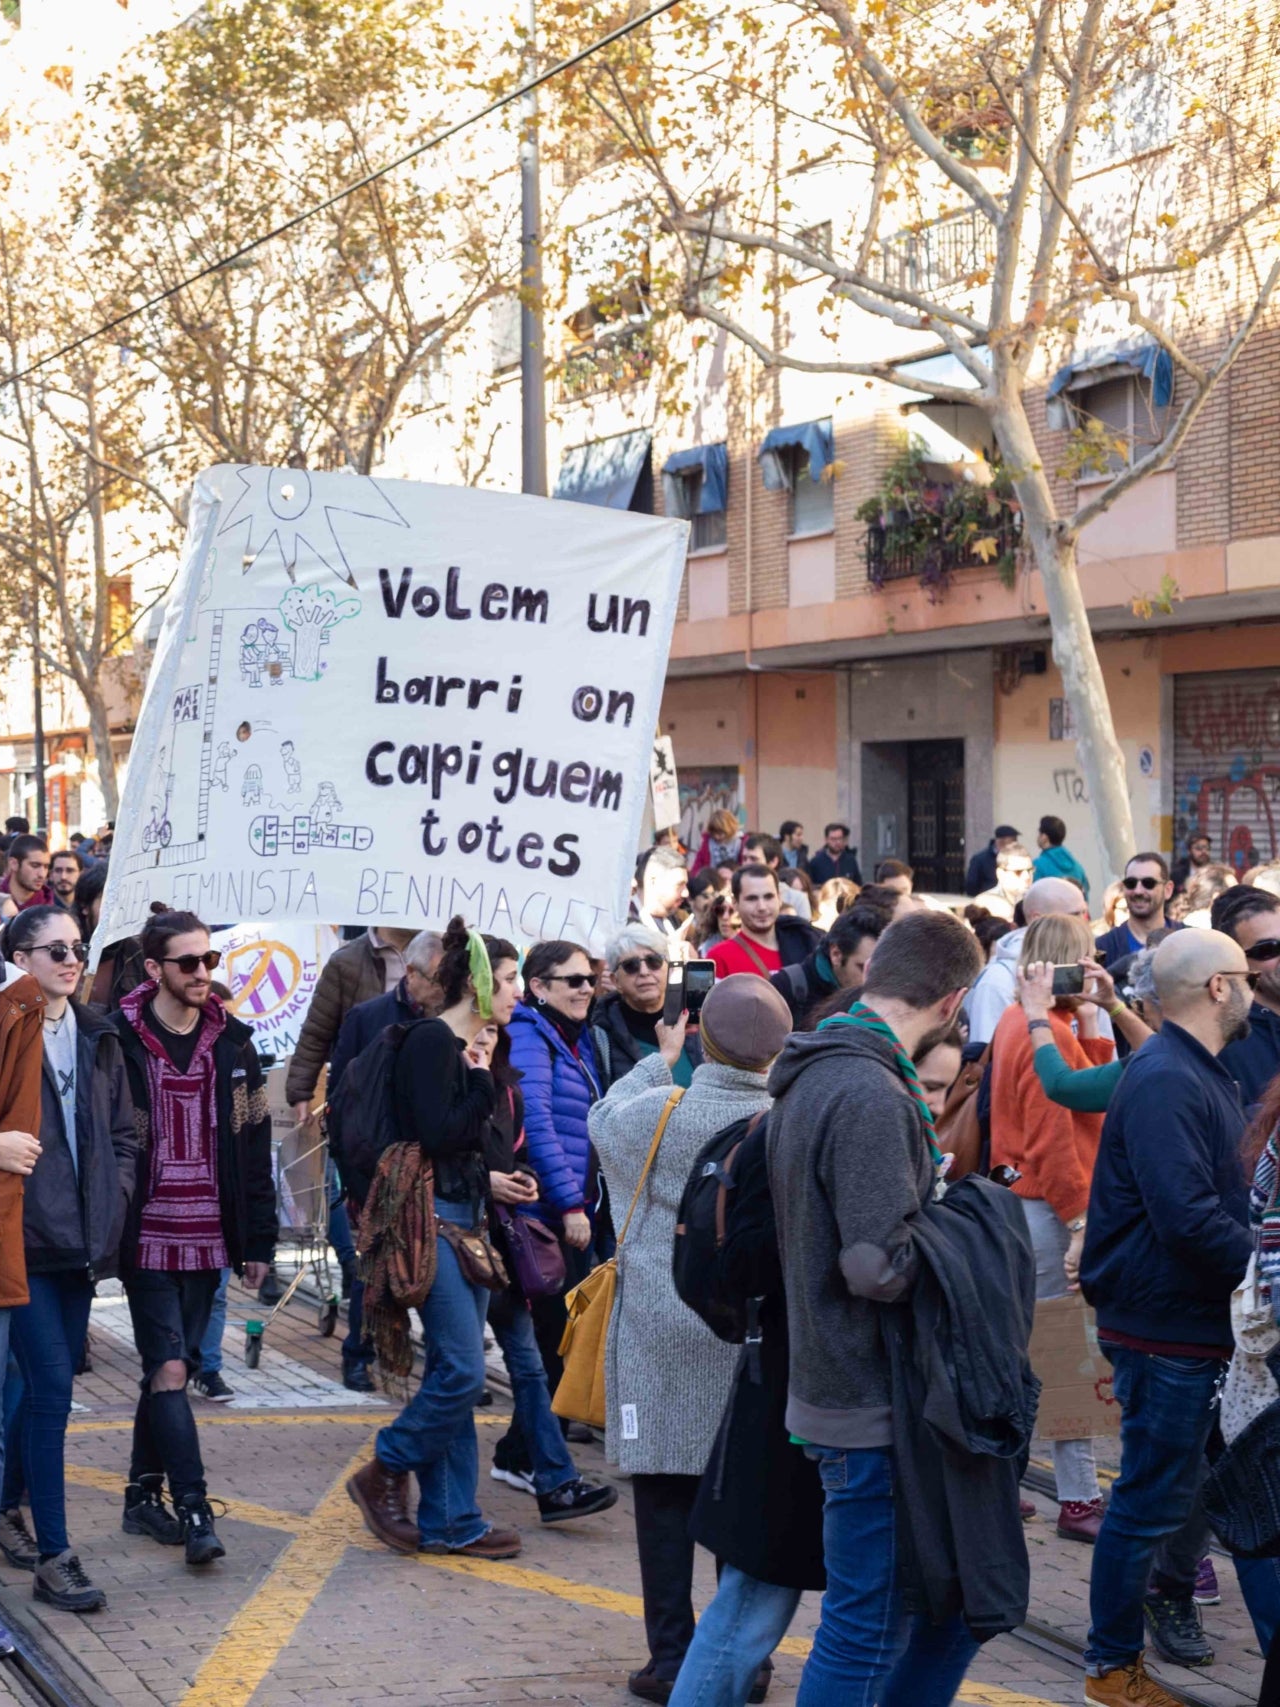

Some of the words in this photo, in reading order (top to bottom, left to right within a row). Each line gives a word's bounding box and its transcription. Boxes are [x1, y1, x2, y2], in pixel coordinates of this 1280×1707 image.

[587, 593, 650, 636] un
[375, 656, 523, 713] barri
[572, 685, 634, 727] on
[365, 740, 623, 811] capiguem
[420, 808, 581, 877] totes
[173, 868, 320, 916] FEMINISTA
[356, 868, 609, 946] BENIMACLET
[247, 960, 317, 1033] ENIMACLET
